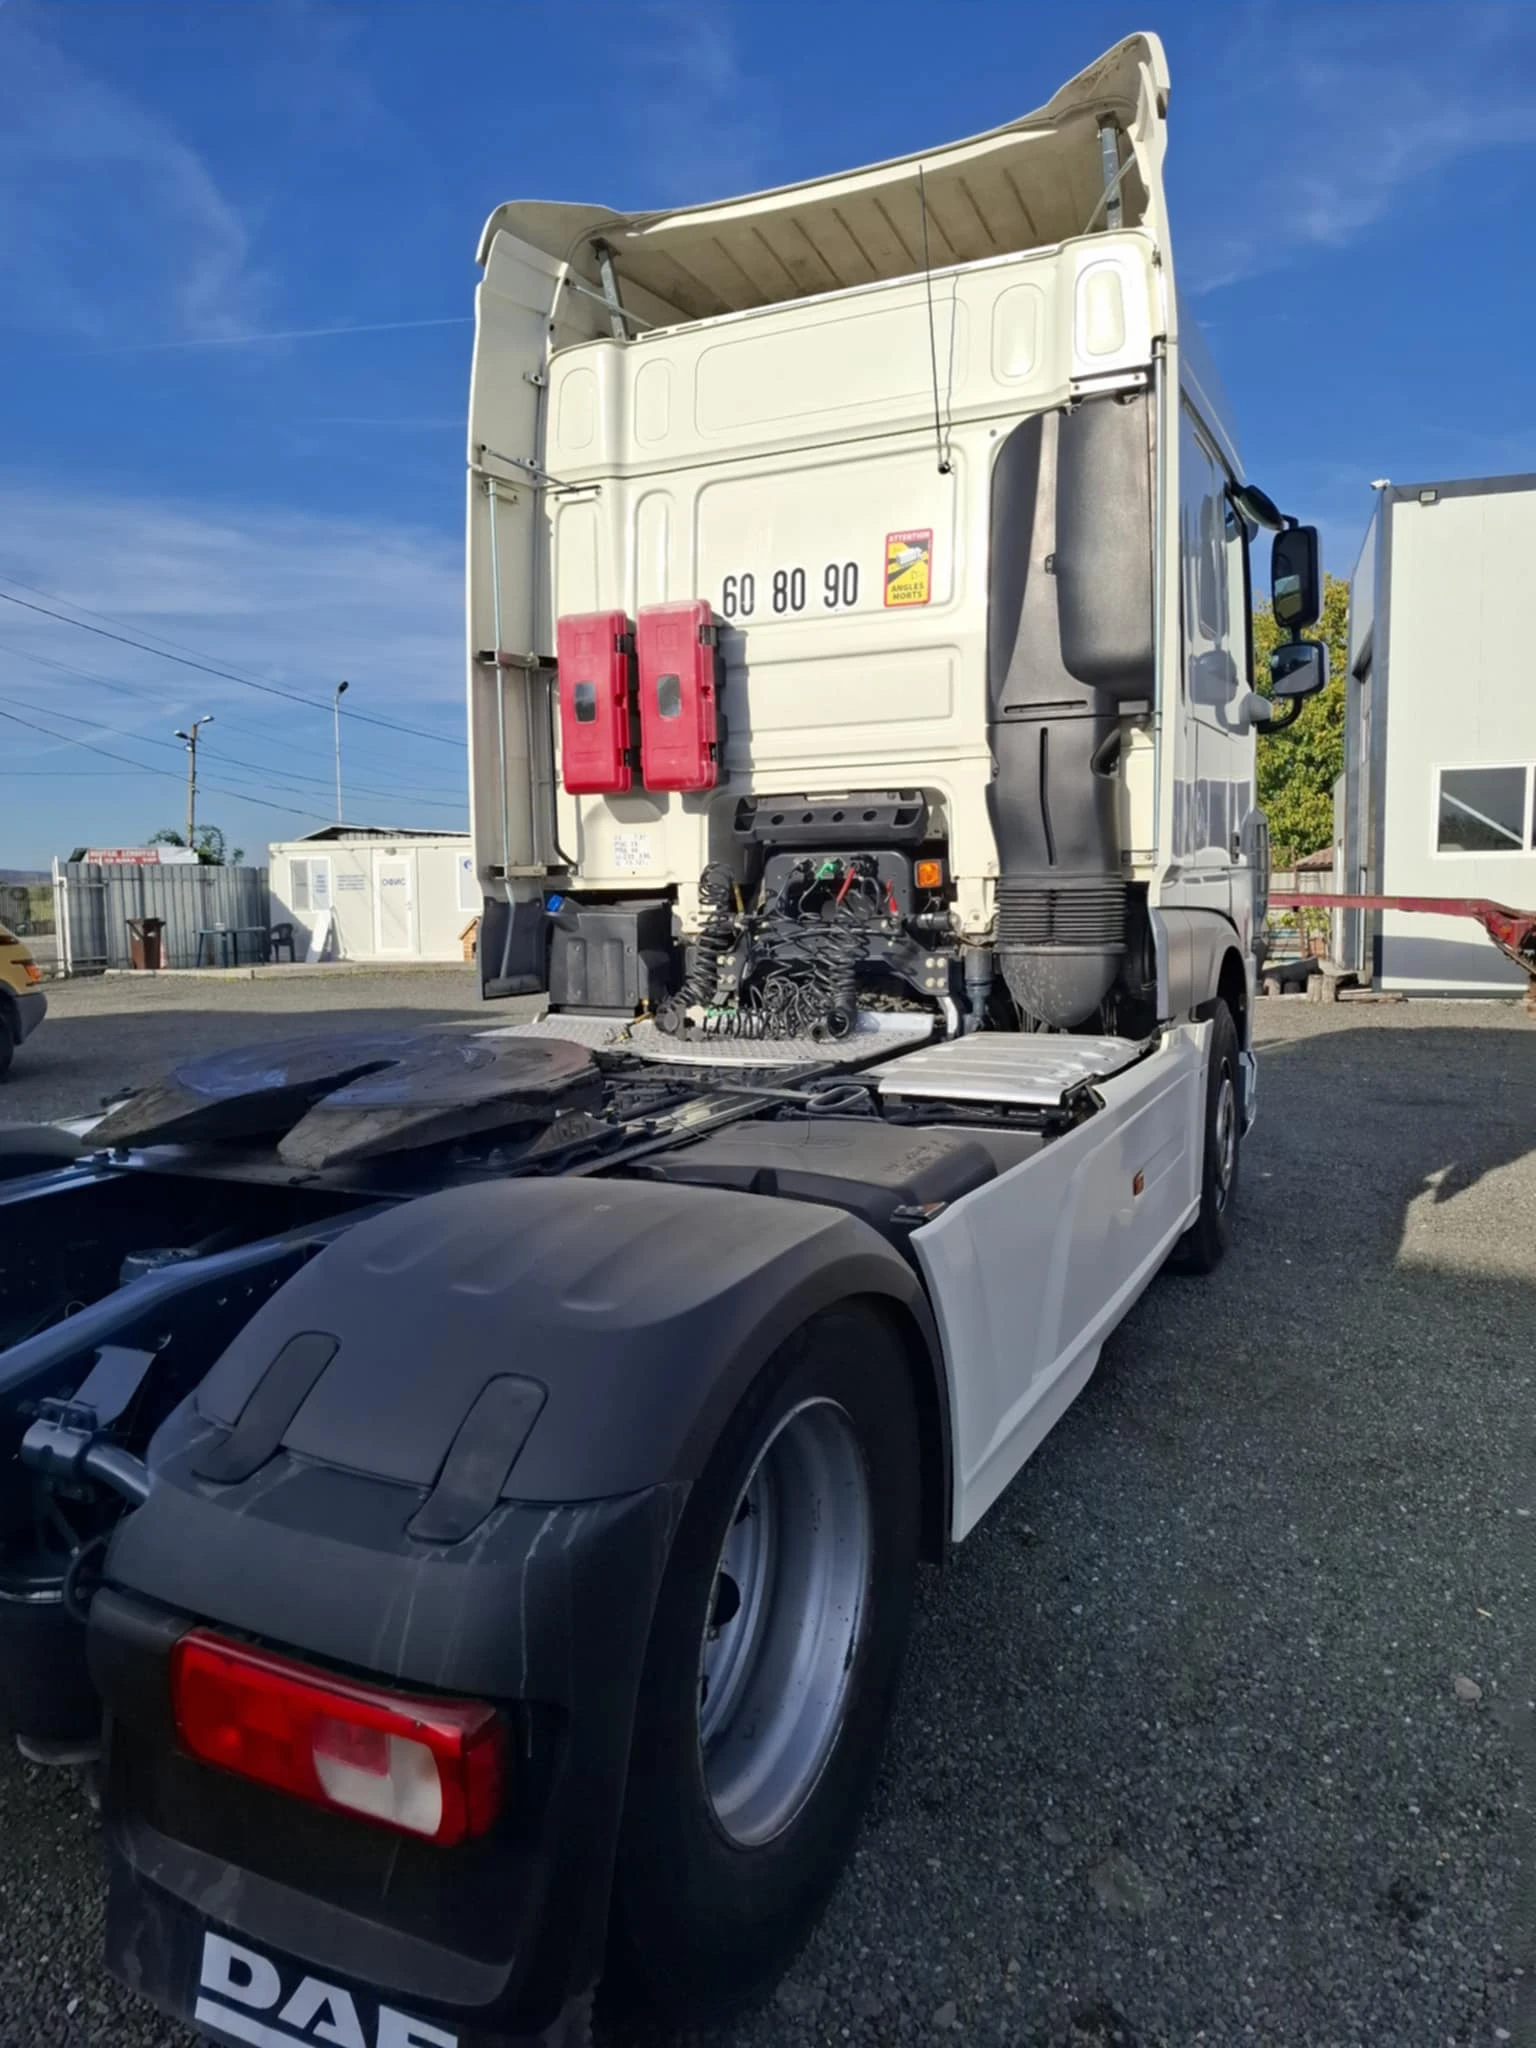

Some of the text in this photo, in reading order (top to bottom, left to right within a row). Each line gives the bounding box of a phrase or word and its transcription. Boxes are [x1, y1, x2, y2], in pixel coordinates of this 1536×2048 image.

[889, 531, 930, 542] ATTENTION
[723, 562, 858, 617] 60 80 90
[891, 581, 924, 592] ANGLES
[893, 591, 922, 600] MORTS
